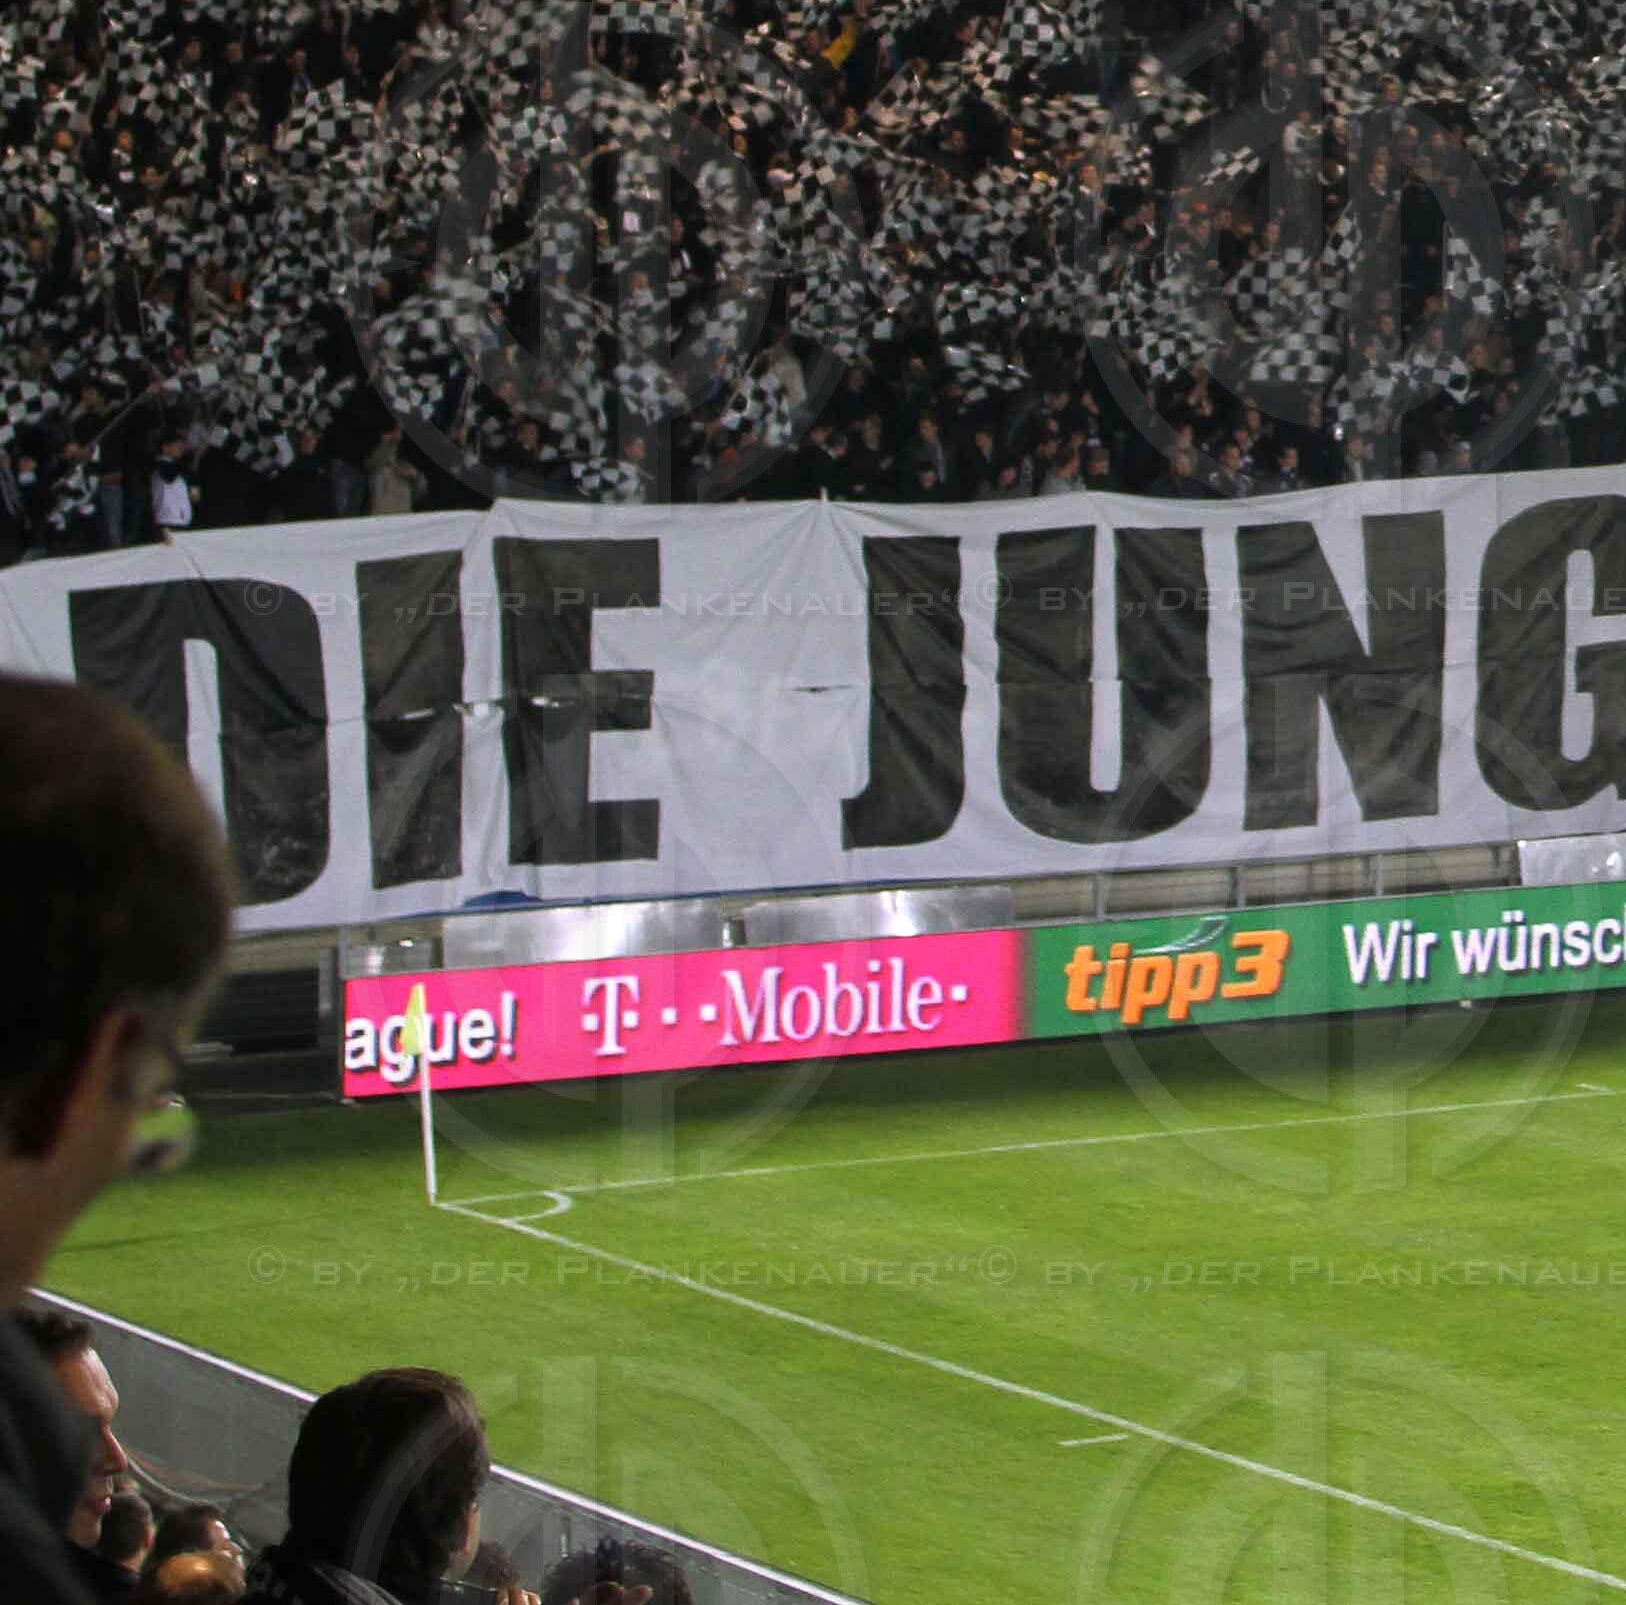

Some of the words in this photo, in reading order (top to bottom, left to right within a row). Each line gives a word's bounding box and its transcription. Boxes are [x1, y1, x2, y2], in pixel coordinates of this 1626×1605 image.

[68, 537, 661, 905] DIE
[1065, 928, 1291, 1024] tipp3
[1344, 920, 1438, 986] Wir
